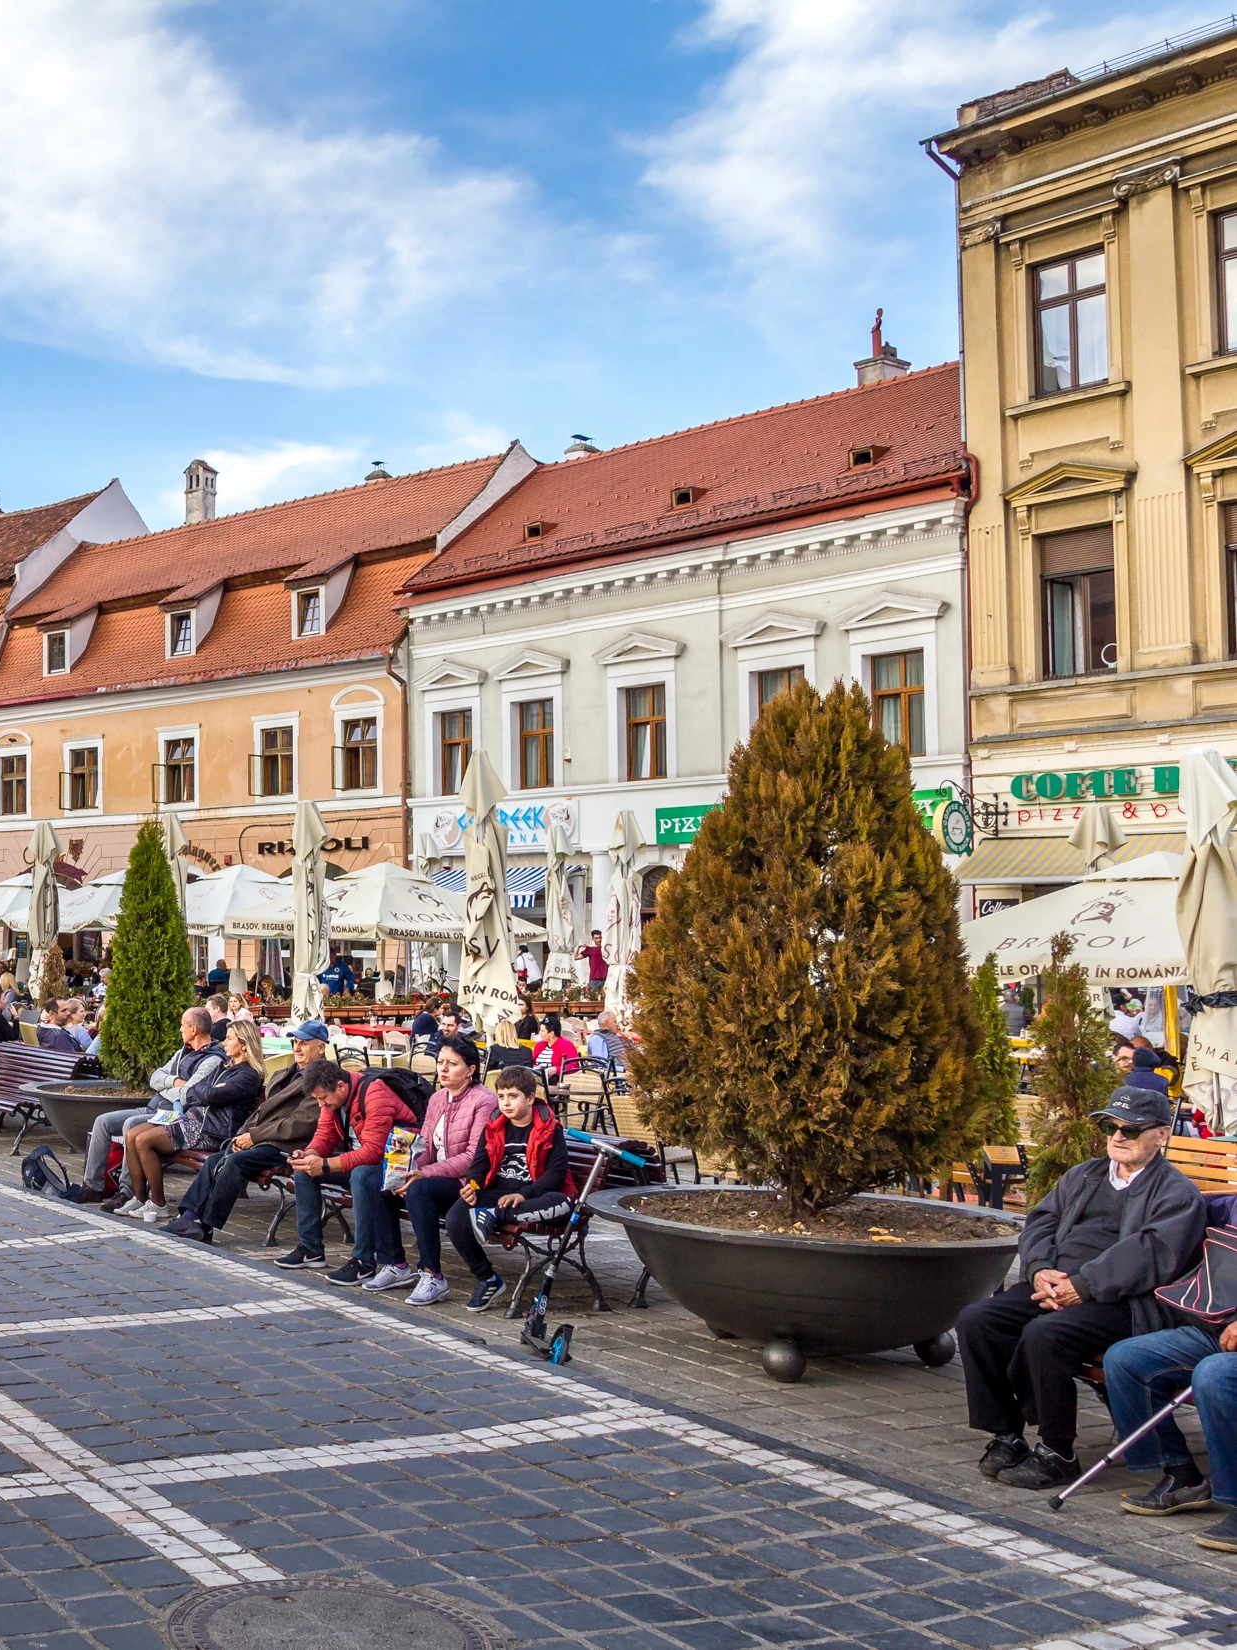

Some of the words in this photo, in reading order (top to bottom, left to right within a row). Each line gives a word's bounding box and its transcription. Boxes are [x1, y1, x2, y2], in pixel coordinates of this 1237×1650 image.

[1010, 768, 1140, 800] COME
[943, 803, 959, 826] COFFEE
[959, 804, 971, 826] SHOP
[1017, 802, 1082, 825] pizz
[470, 872, 488, 882] REGEL
[262, 923, 285, 932] REGELE
[424, 930, 452, 940] REGELE
[1095, 964, 1111, 978] ÎN
